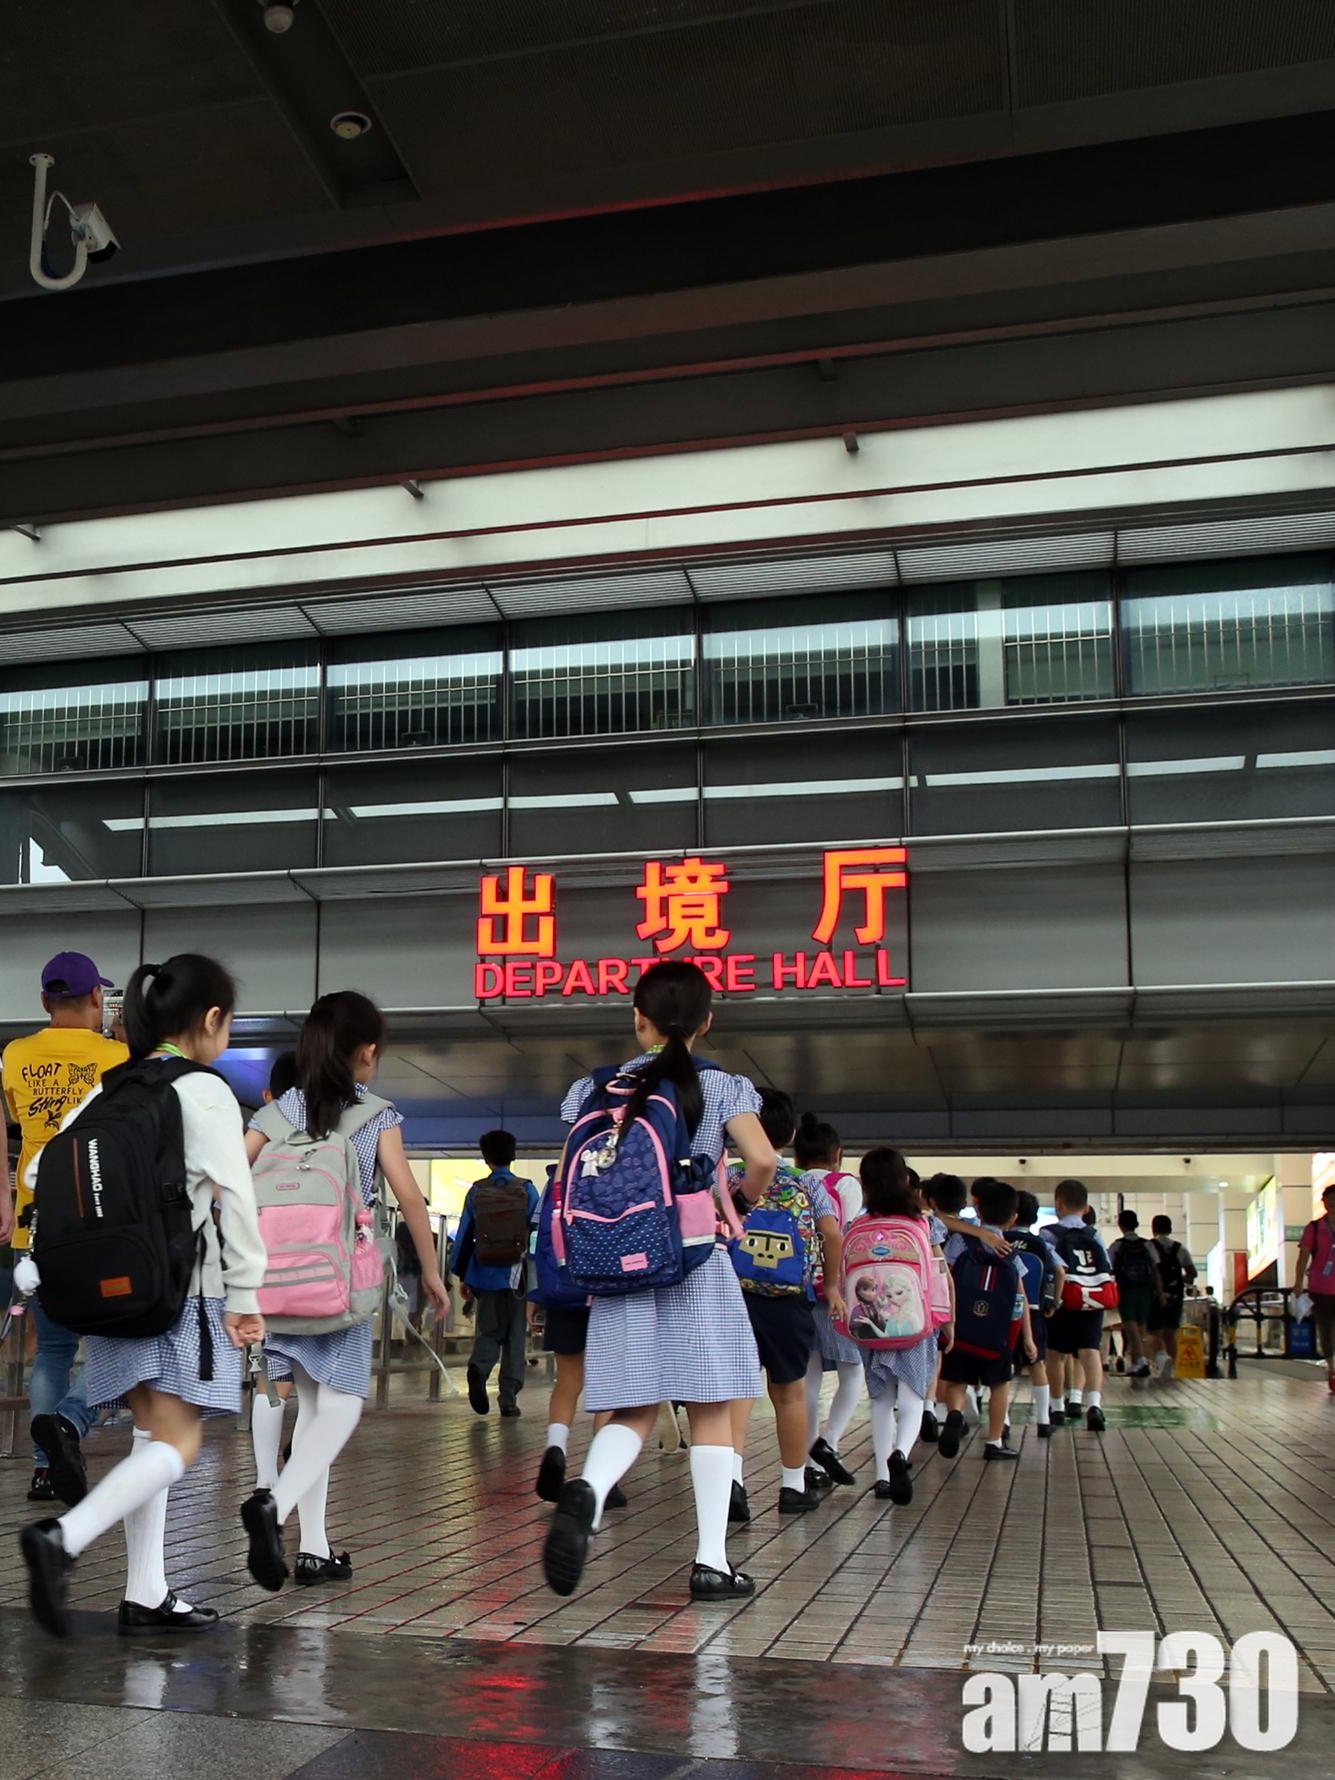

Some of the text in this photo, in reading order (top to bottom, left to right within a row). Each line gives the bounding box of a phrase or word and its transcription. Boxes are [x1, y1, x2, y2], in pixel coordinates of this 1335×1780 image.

[476, 847, 908, 958] 出境厅
[474, 949, 908, 999] DEPARTRE HALL
[21, 1062, 62, 1082] FLOAT
[27, 1079, 59, 1088] LIKE A
[32, 1087, 83, 1096] BUTTERFLY
[67, 1097, 81, 1105] LIK
